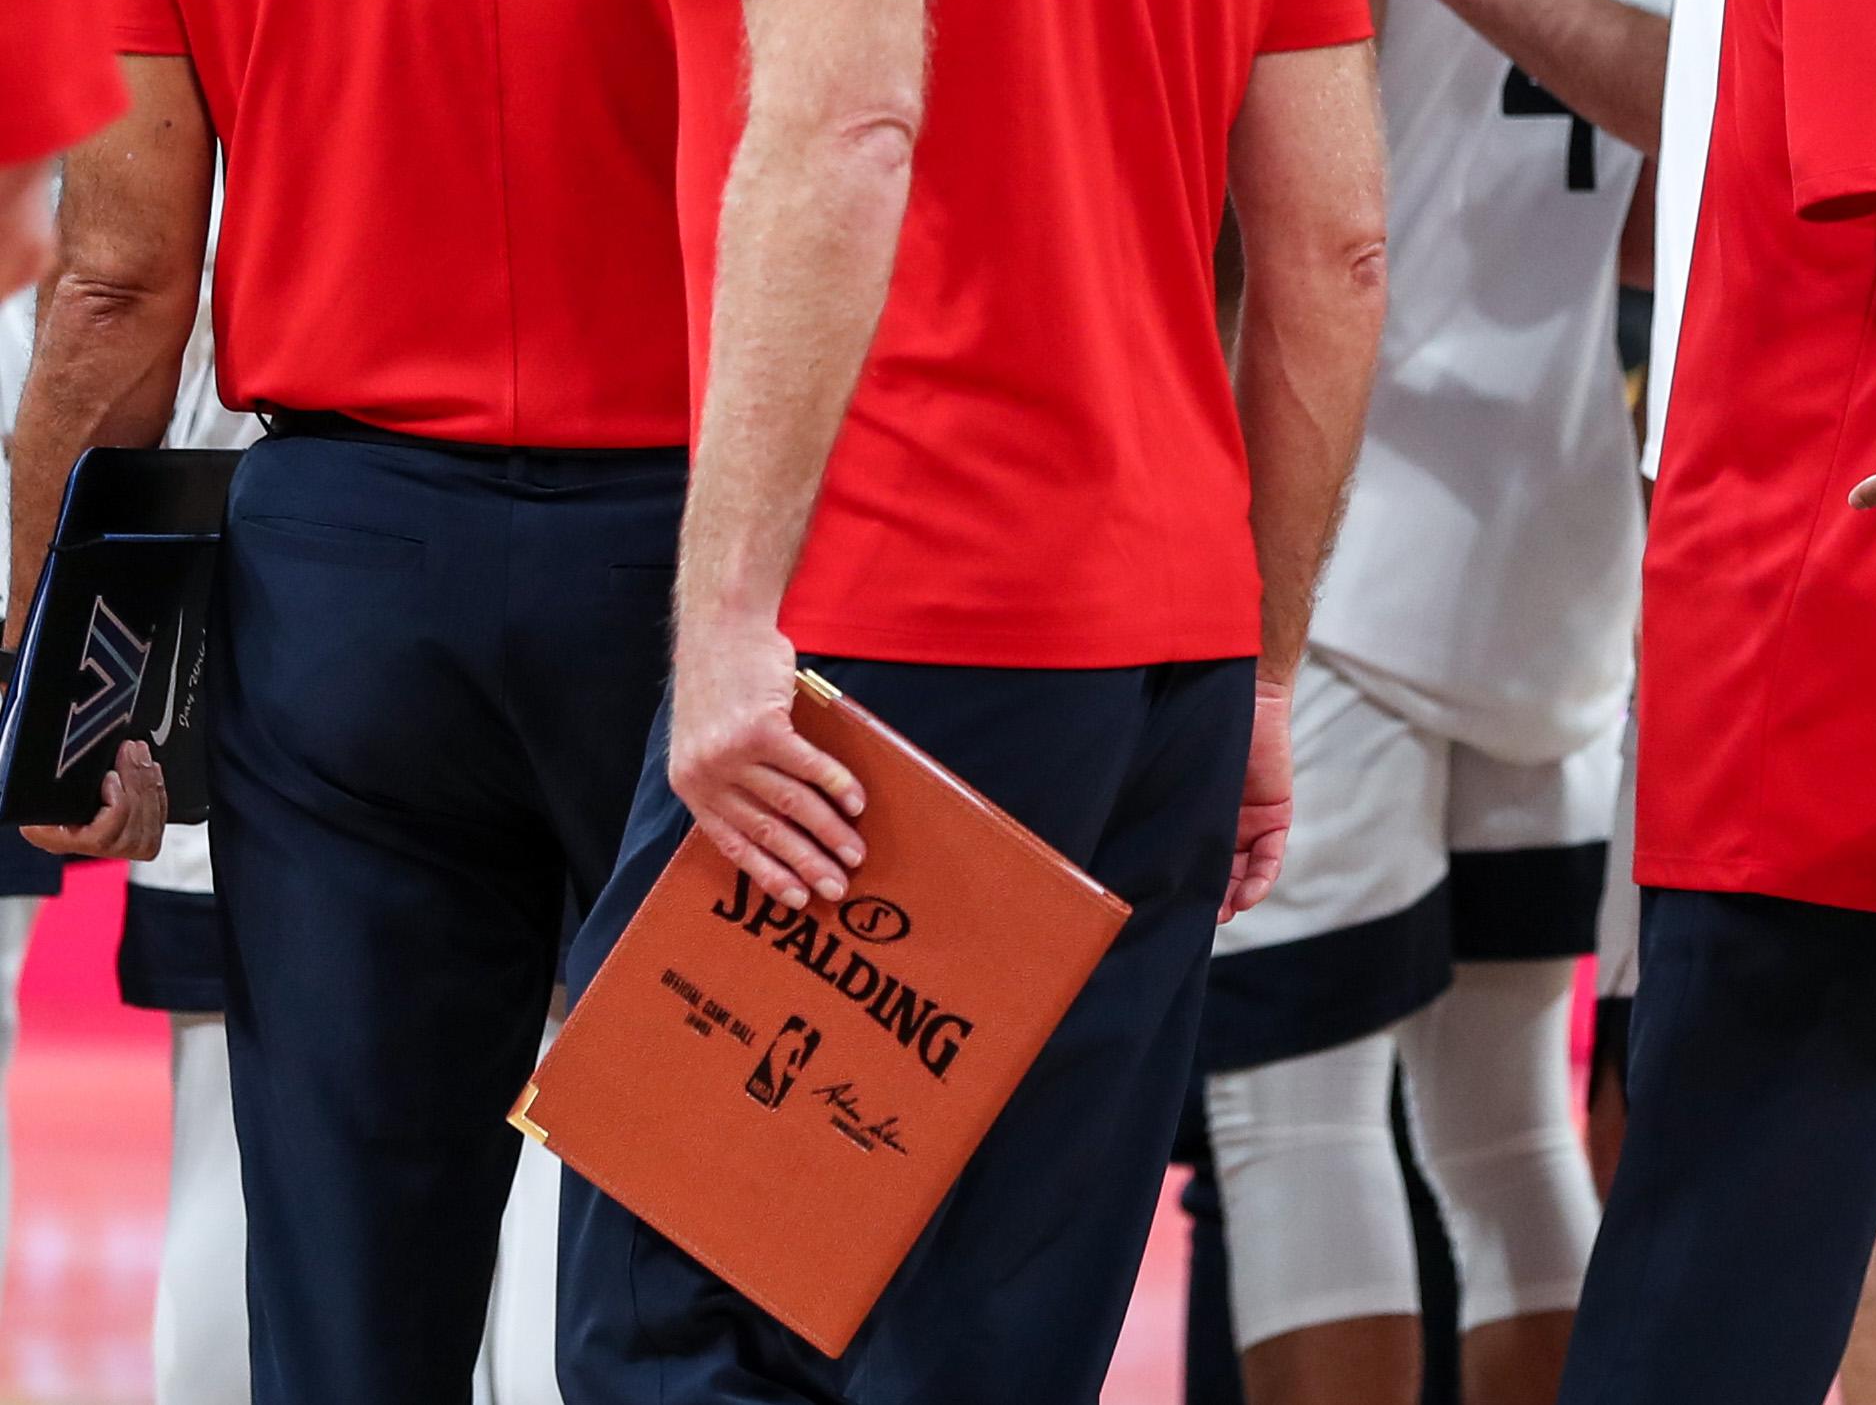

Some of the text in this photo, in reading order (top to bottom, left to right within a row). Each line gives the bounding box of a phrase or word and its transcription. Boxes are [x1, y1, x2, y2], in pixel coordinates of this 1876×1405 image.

[702, 999, 731, 1028] GAME
[729, 1019, 756, 1046] BALL
[711, 867, 974, 1080] SPALDING
